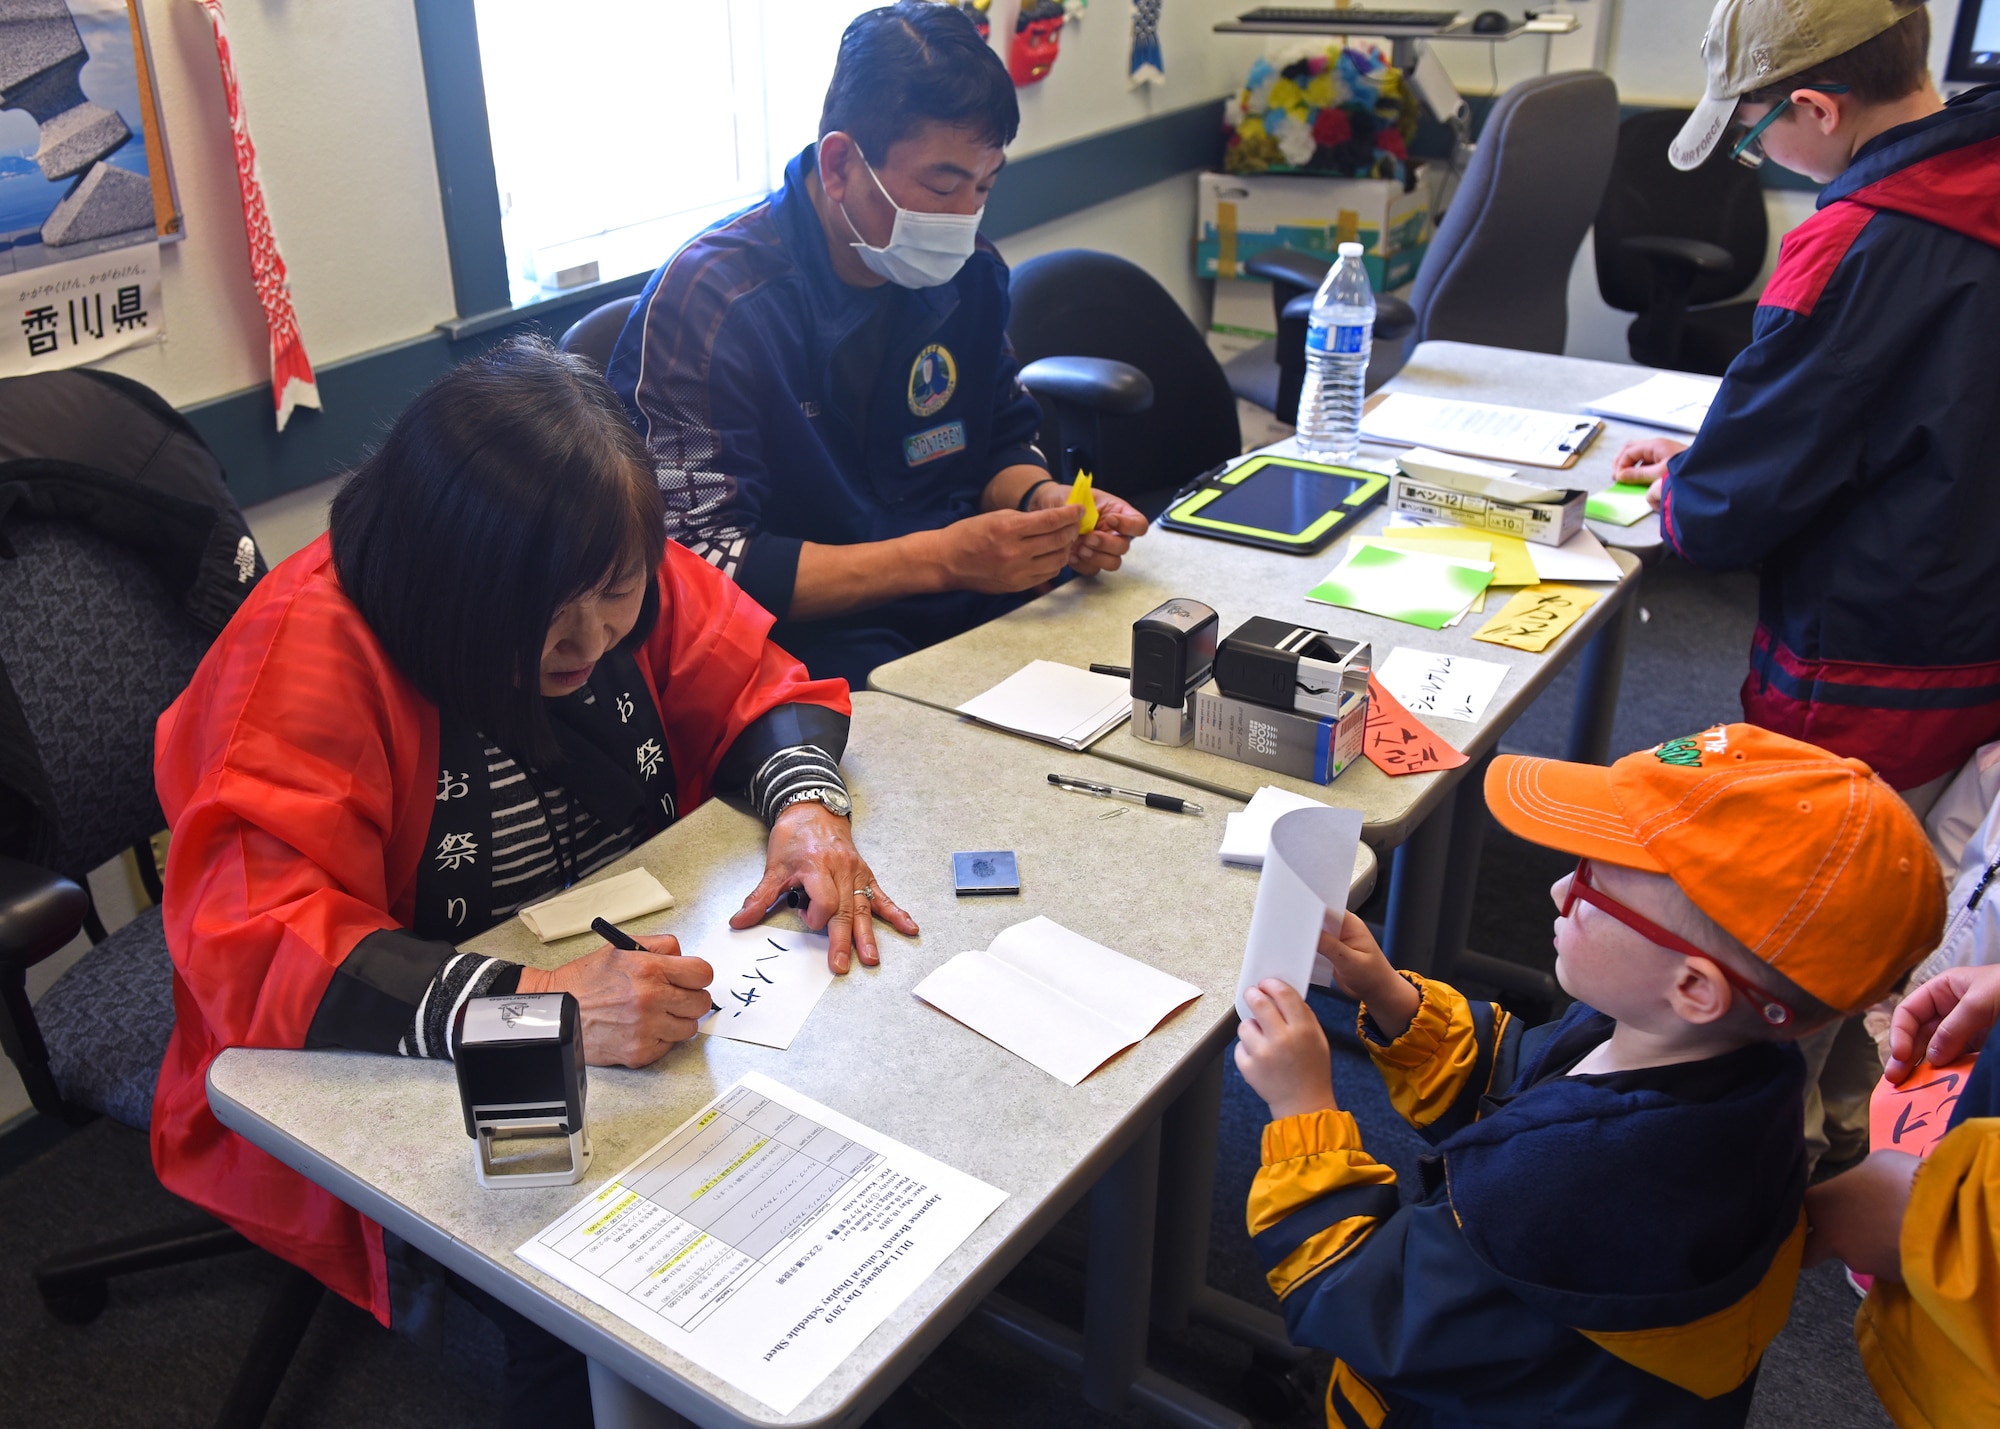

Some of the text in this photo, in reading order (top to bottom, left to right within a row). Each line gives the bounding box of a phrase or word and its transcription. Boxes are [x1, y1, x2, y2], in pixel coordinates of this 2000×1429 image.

[1680, 150, 1696, 166] AIR
[1696, 116, 1722, 158] FORCE
[21, 284, 148, 357] 香川県
[912, 425, 962, 458] MONTEREY
[1256, 723, 1267, 753] 2000
[1704, 728, 1728, 754] THE
[616, 692, 675, 820] お祭り
[435, 770, 478, 927] お祭り
[841, 1167, 892, 1211] POC: Kazuki Arita
[876, 1172, 899, 1192] Activity:
[892, 1176, 910, 1190] Place:
[900, 1181, 919, 1194] Time:
[910, 1184, 927, 1197] Date:
[878, 1190, 894, 1202] Bldg
[898, 1198, 913, 1208] May
[870, 1202, 882, 1212] 211
[882, 1200, 895, 1211] a.m.
[854, 1211, 872, 1226] Room
[860, 1220, 873, 1231] p.m.
[878, 1216, 893, 1230] 2019
[763, 1193, 941, 1361] Japanese Branch Cultural Display Schedule Sheet
[824, 1239, 913, 1323] DLI Language Day 2019
[715, 1288, 733, 1303] Teacher
